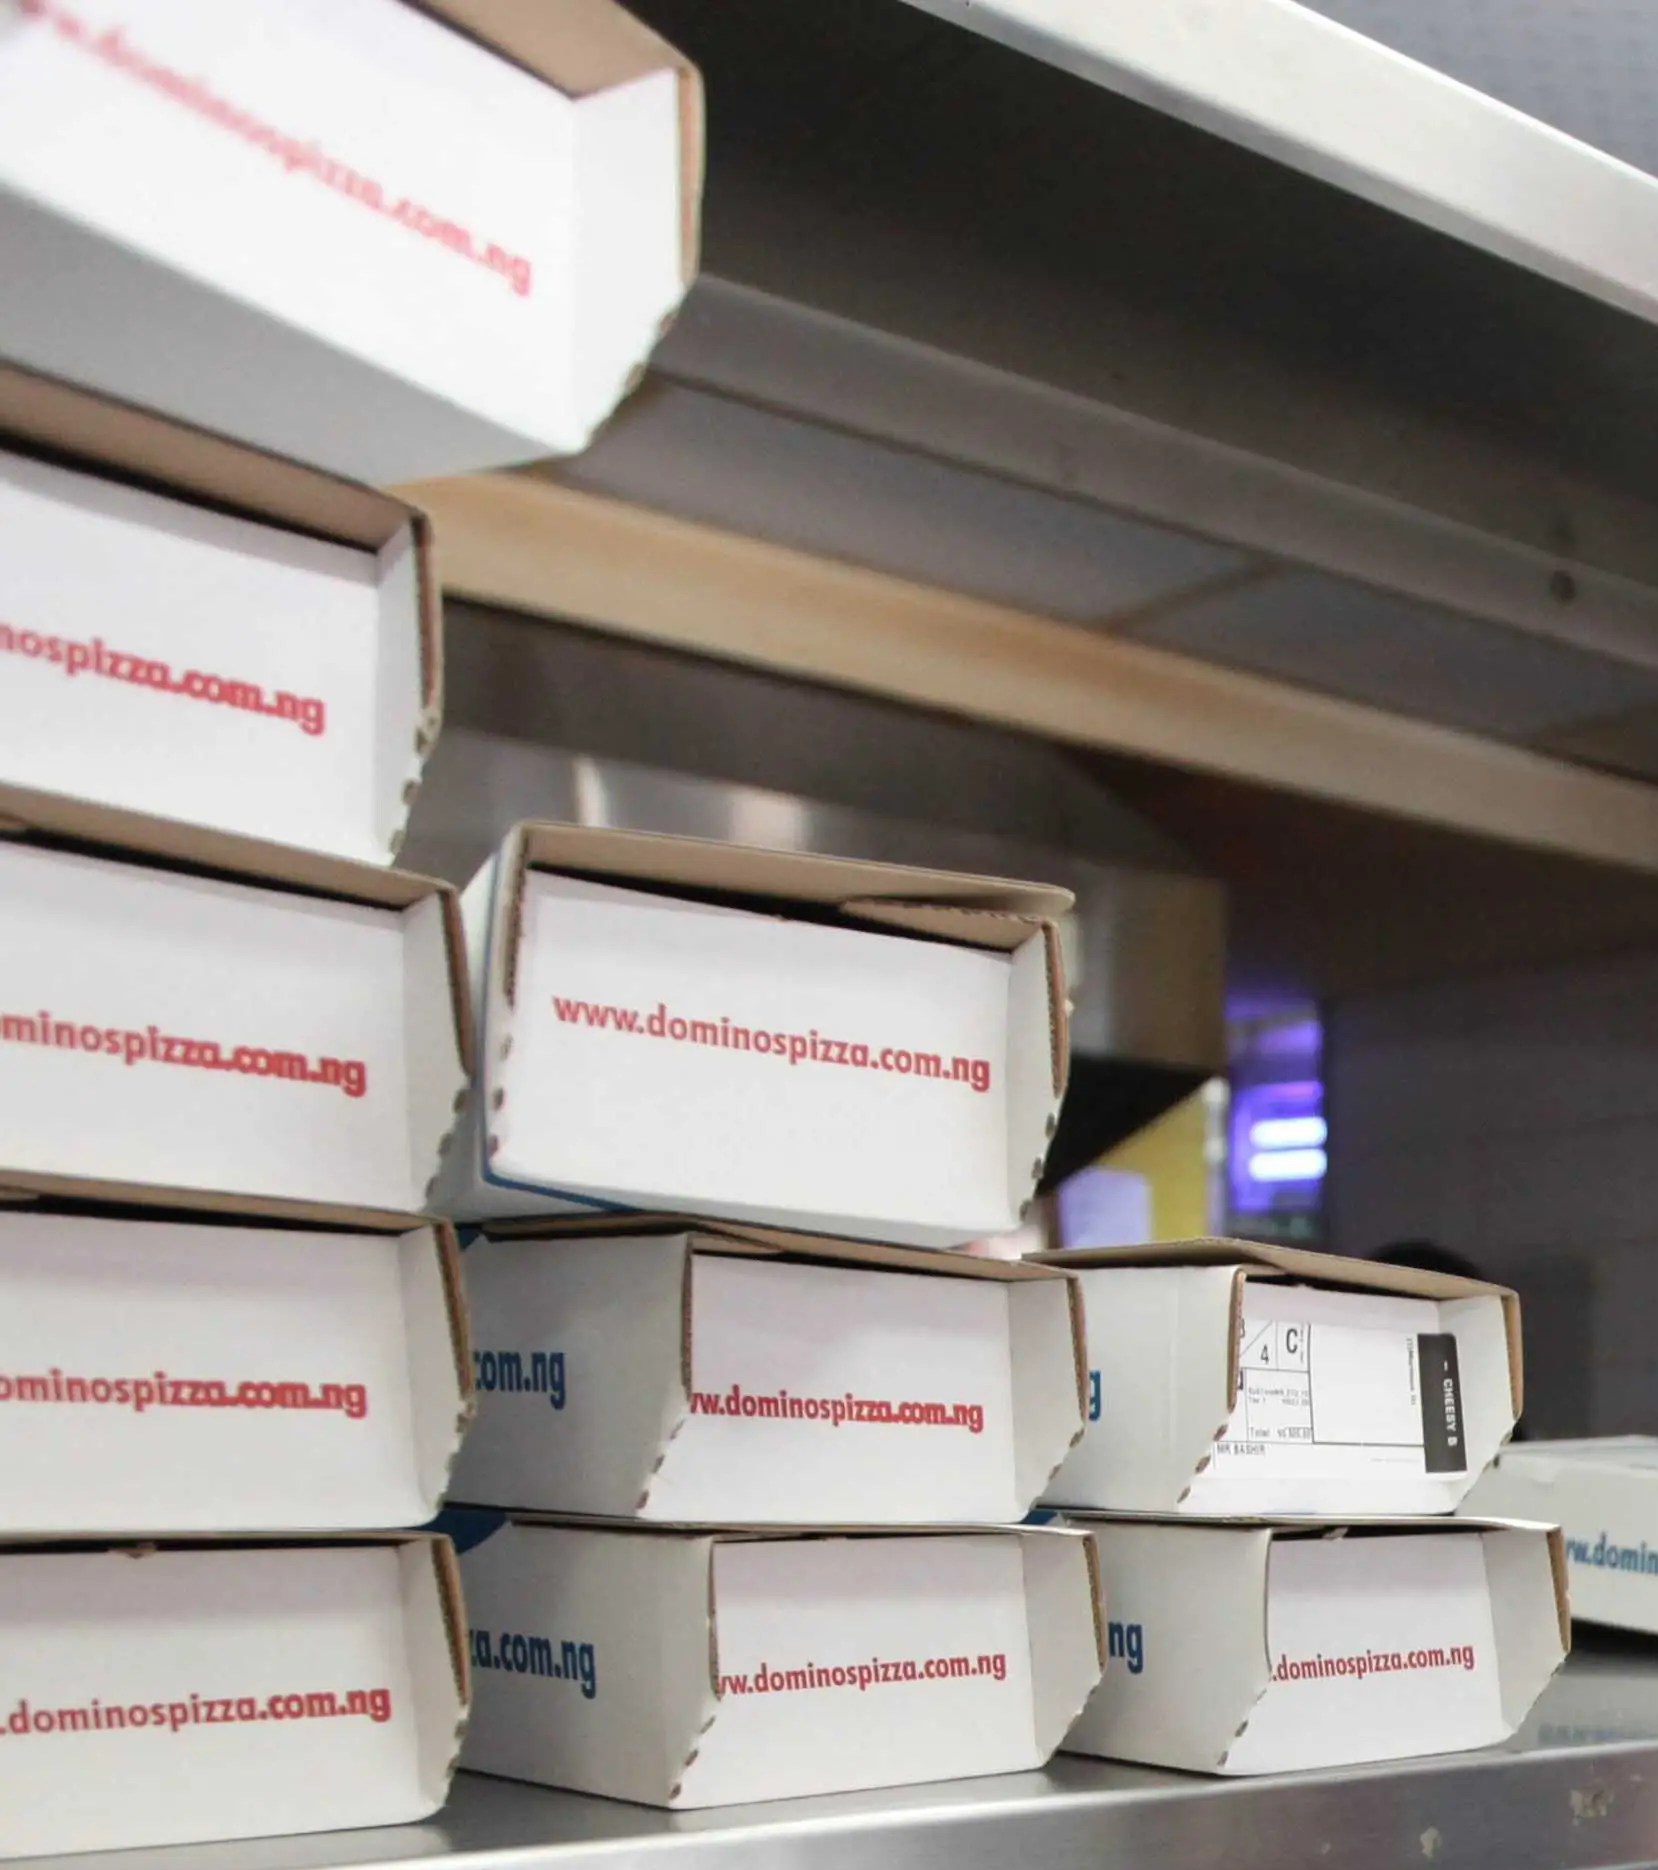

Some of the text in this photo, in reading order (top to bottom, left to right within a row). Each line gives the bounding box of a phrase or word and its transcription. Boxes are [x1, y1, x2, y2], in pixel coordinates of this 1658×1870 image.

[553, 994, 991, 1092] www.dominospizza.com.ng
[1258, 1344, 1271, 1365] 4
[1286, 1328, 1299, 1353] C
[1443, 1378, 1457, 1432] CHEESY
